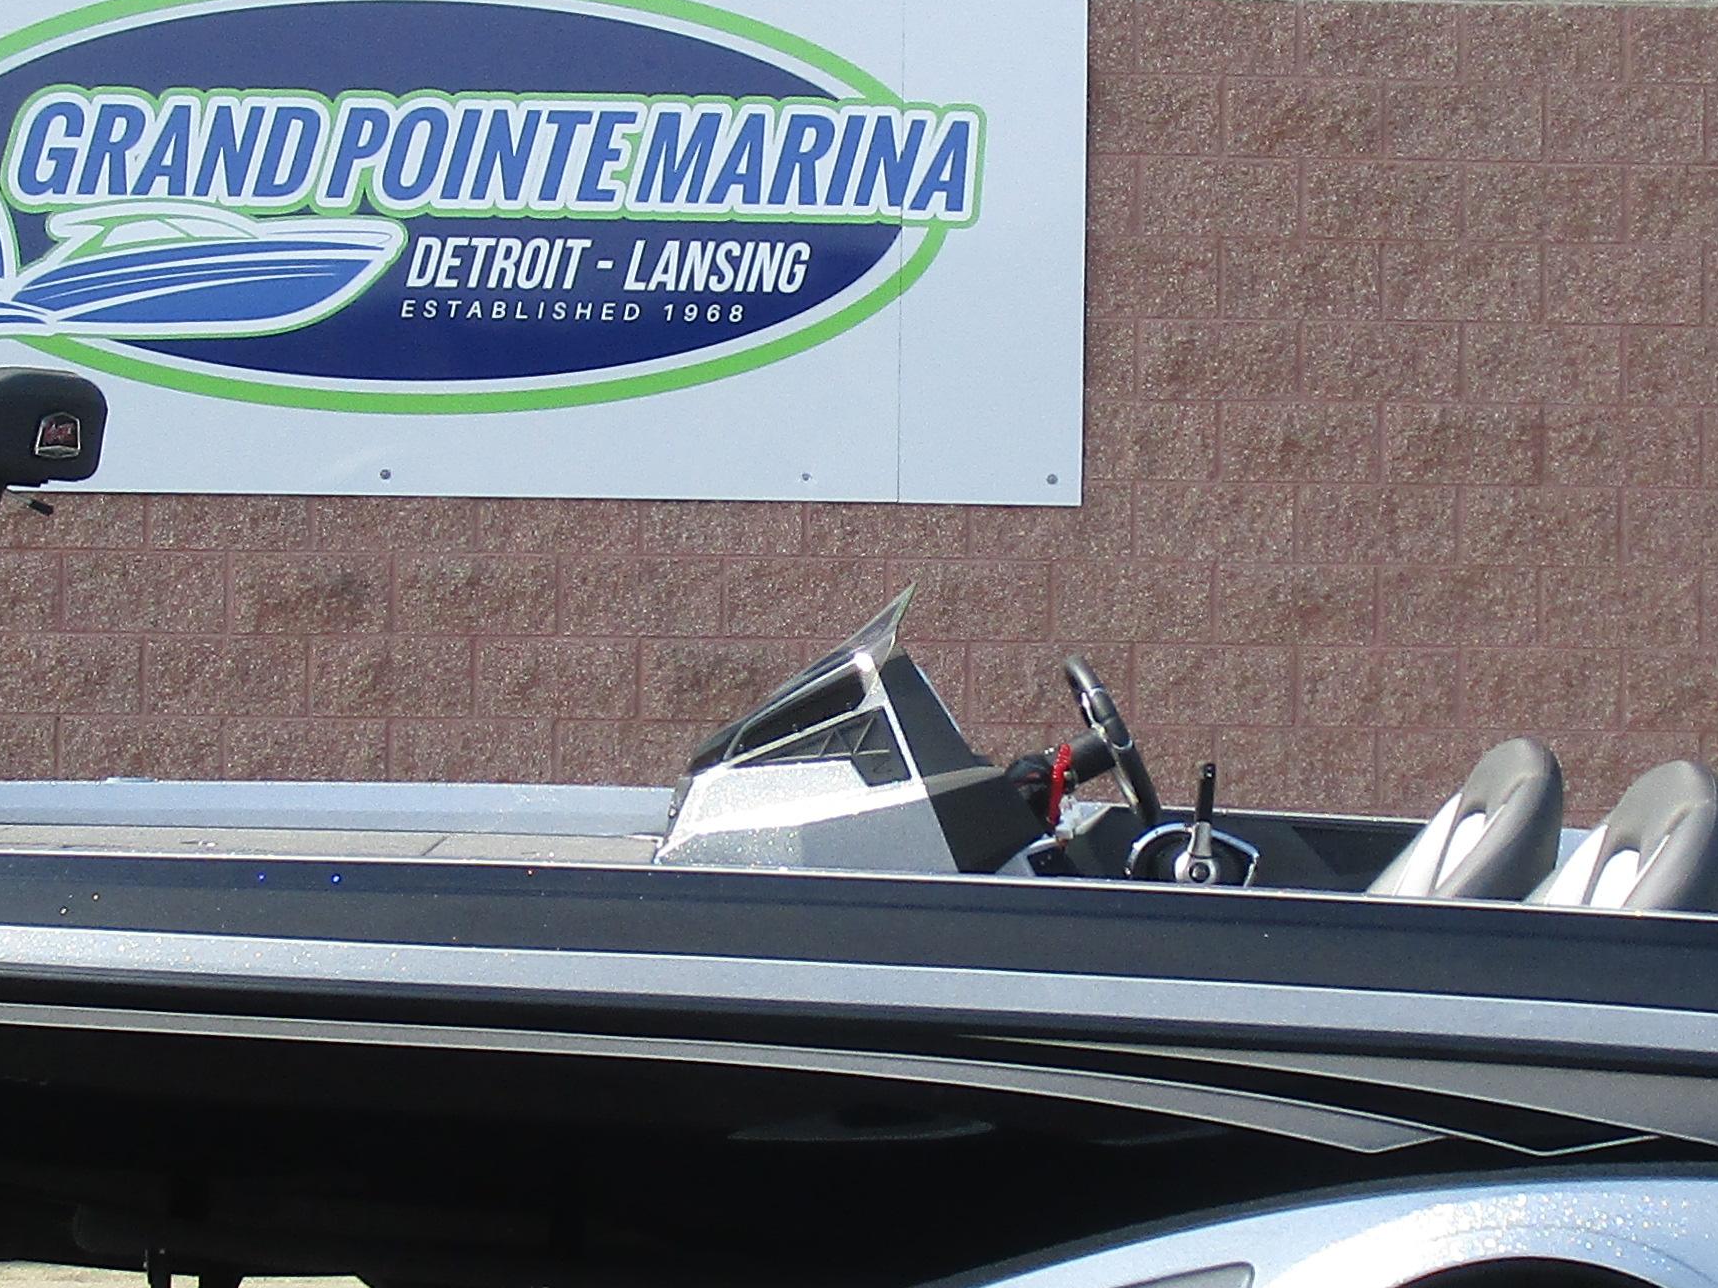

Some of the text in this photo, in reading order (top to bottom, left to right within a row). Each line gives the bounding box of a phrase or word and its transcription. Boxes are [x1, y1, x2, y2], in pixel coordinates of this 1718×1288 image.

[16, 101, 972, 213] GRAND POINTE MARINA
[405, 236, 592, 290] DETROIT
[622, 239, 813, 294] LANSING
[400, 299, 746, 324] ESTABLISHED 1968
